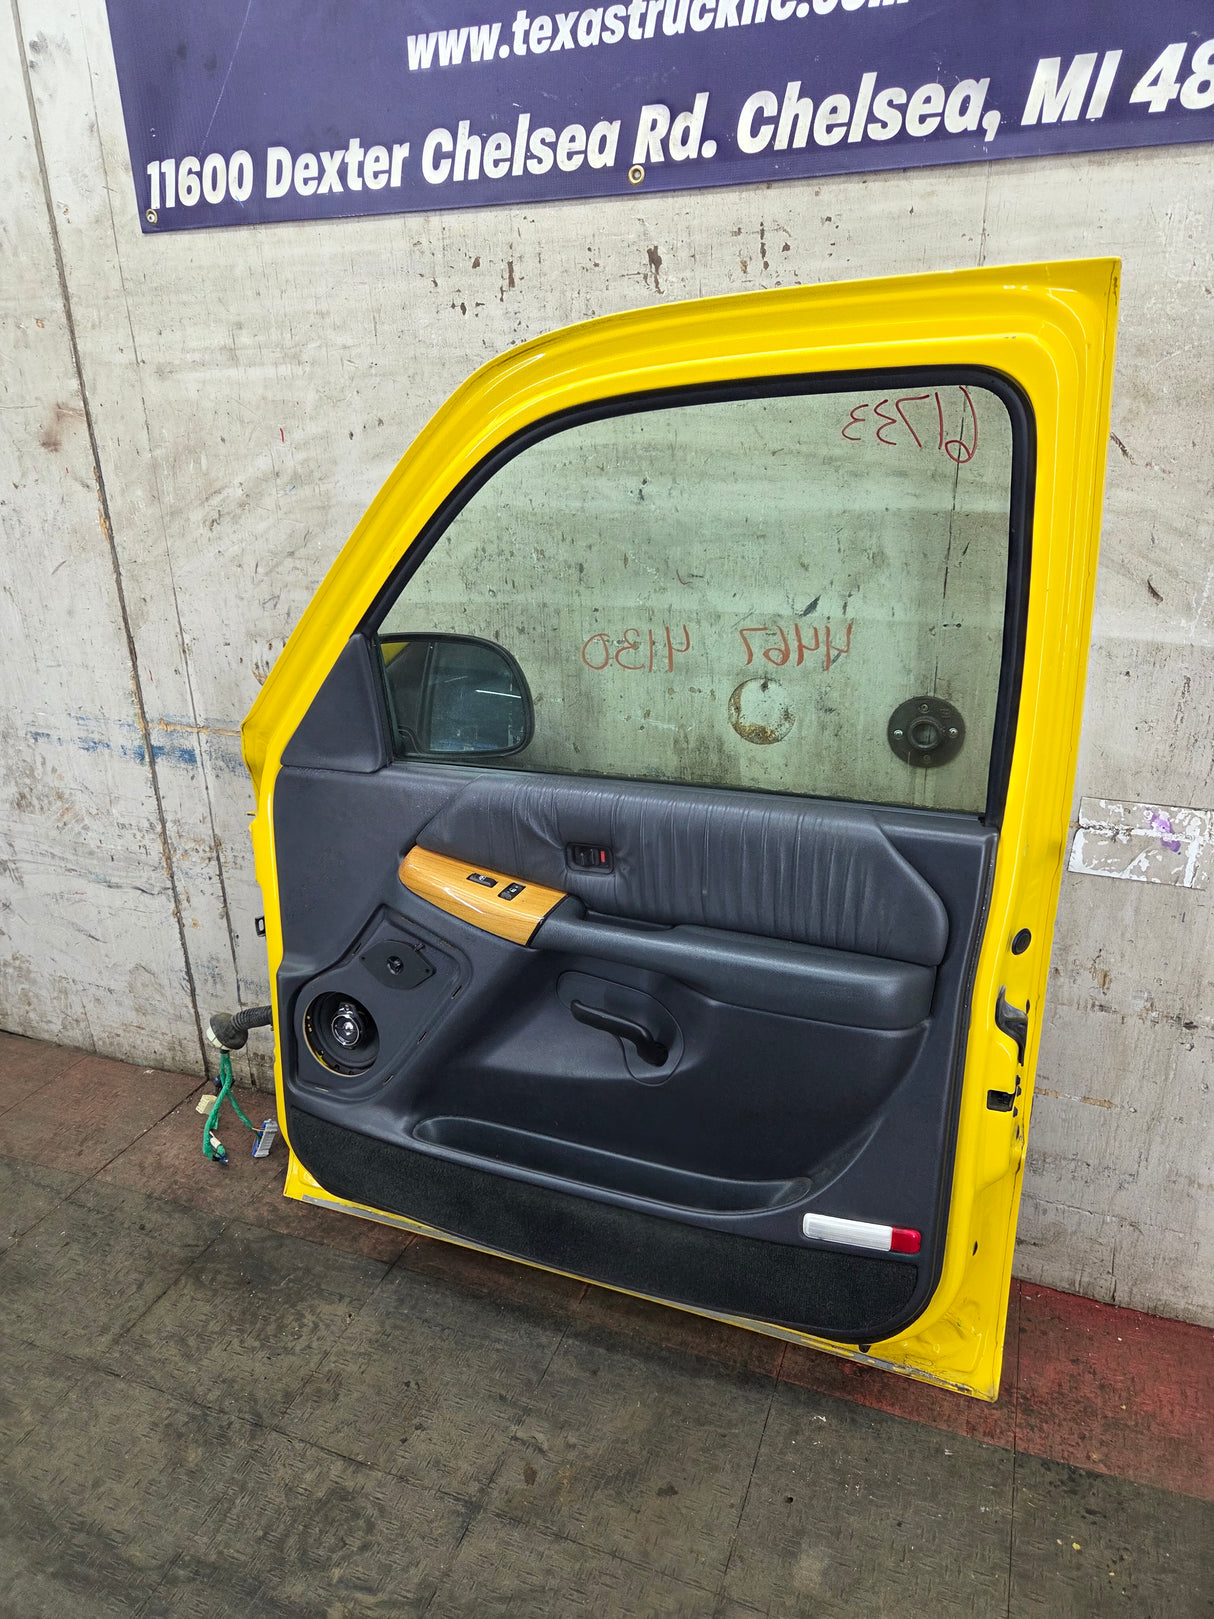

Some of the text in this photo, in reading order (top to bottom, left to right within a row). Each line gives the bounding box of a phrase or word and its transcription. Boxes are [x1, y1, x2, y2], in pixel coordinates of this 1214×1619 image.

[146, 38, 1214, 209] 11600 Dexter Chelsea Rd. Chelsea, MI 48
